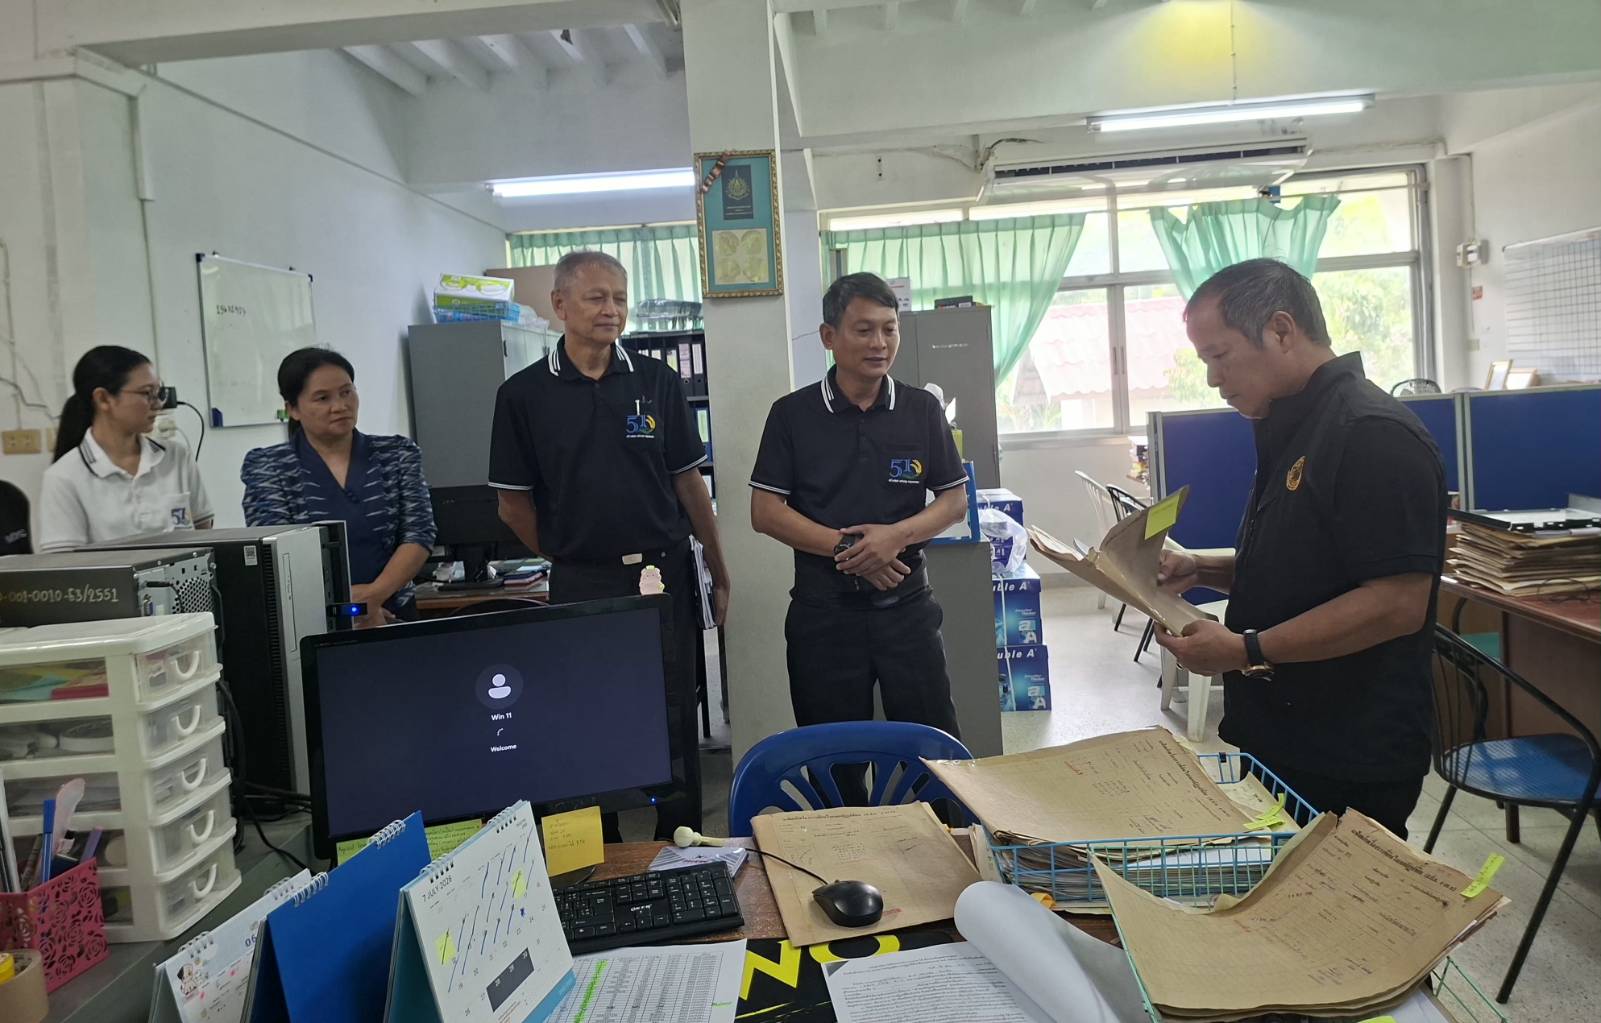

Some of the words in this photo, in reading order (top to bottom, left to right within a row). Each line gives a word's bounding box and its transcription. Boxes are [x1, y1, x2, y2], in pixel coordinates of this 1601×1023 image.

[1019, 581, 1027, 591] A
[1026, 648, 1035, 658] A
[491, 713, 505, 721] Win
[505, 711, 512, 719] 11
[490, 744, 517, 753] Welcome
